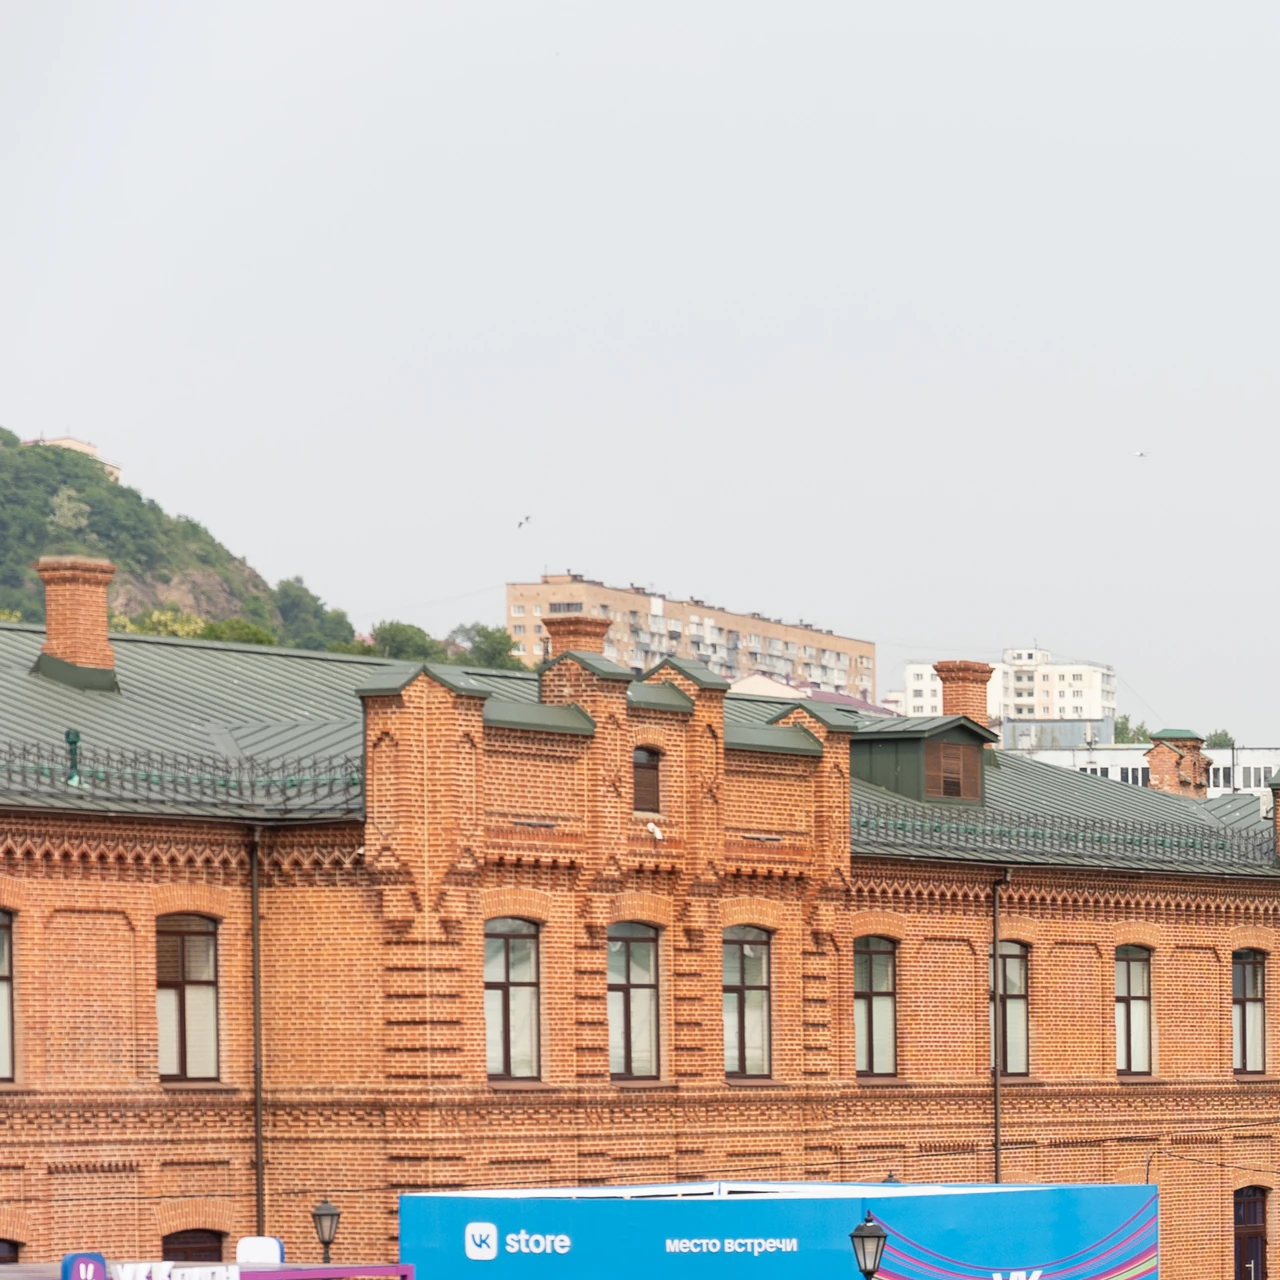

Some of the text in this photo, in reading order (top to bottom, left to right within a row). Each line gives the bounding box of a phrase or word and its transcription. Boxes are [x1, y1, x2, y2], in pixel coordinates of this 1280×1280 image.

[472, 1234, 490, 1249] VK
[505, 1230, 571, 1254] store
[665, 1238, 797, 1256] место встречи
